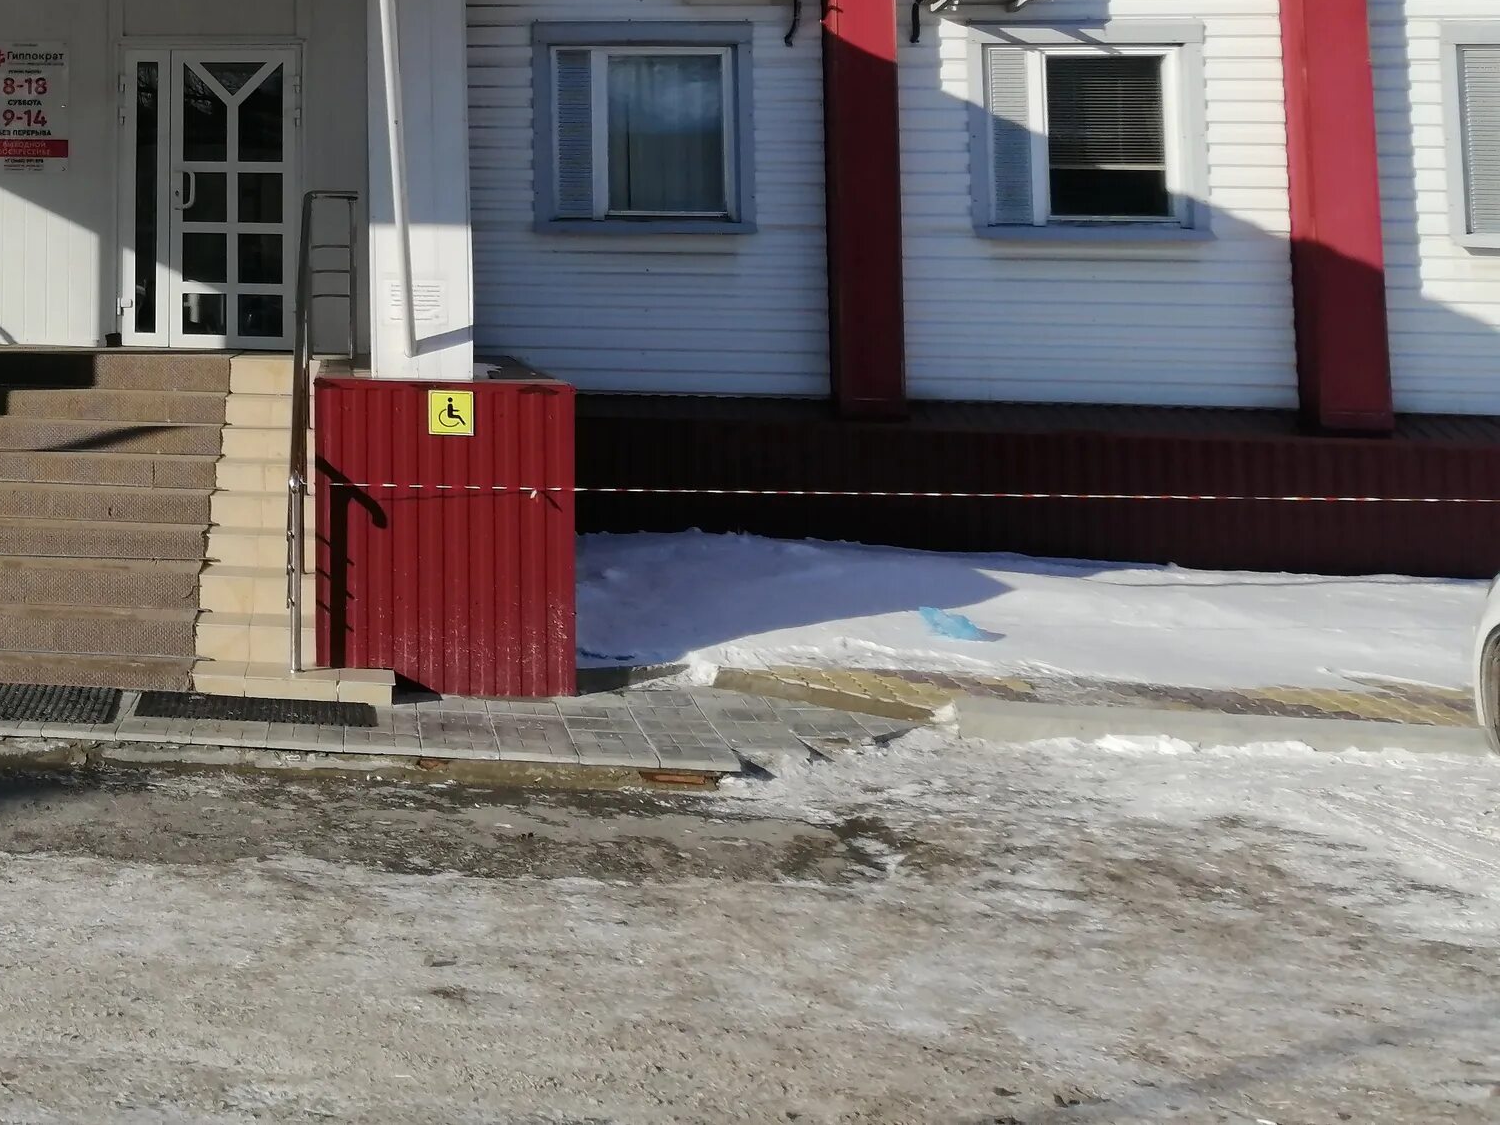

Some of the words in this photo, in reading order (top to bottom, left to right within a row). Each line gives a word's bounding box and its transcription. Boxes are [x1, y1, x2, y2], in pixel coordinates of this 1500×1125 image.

[7, 51, 64, 62] Гиппократ
[2, 77, 48, 95] 8-18
[2, 109, 48, 127] 9-14
